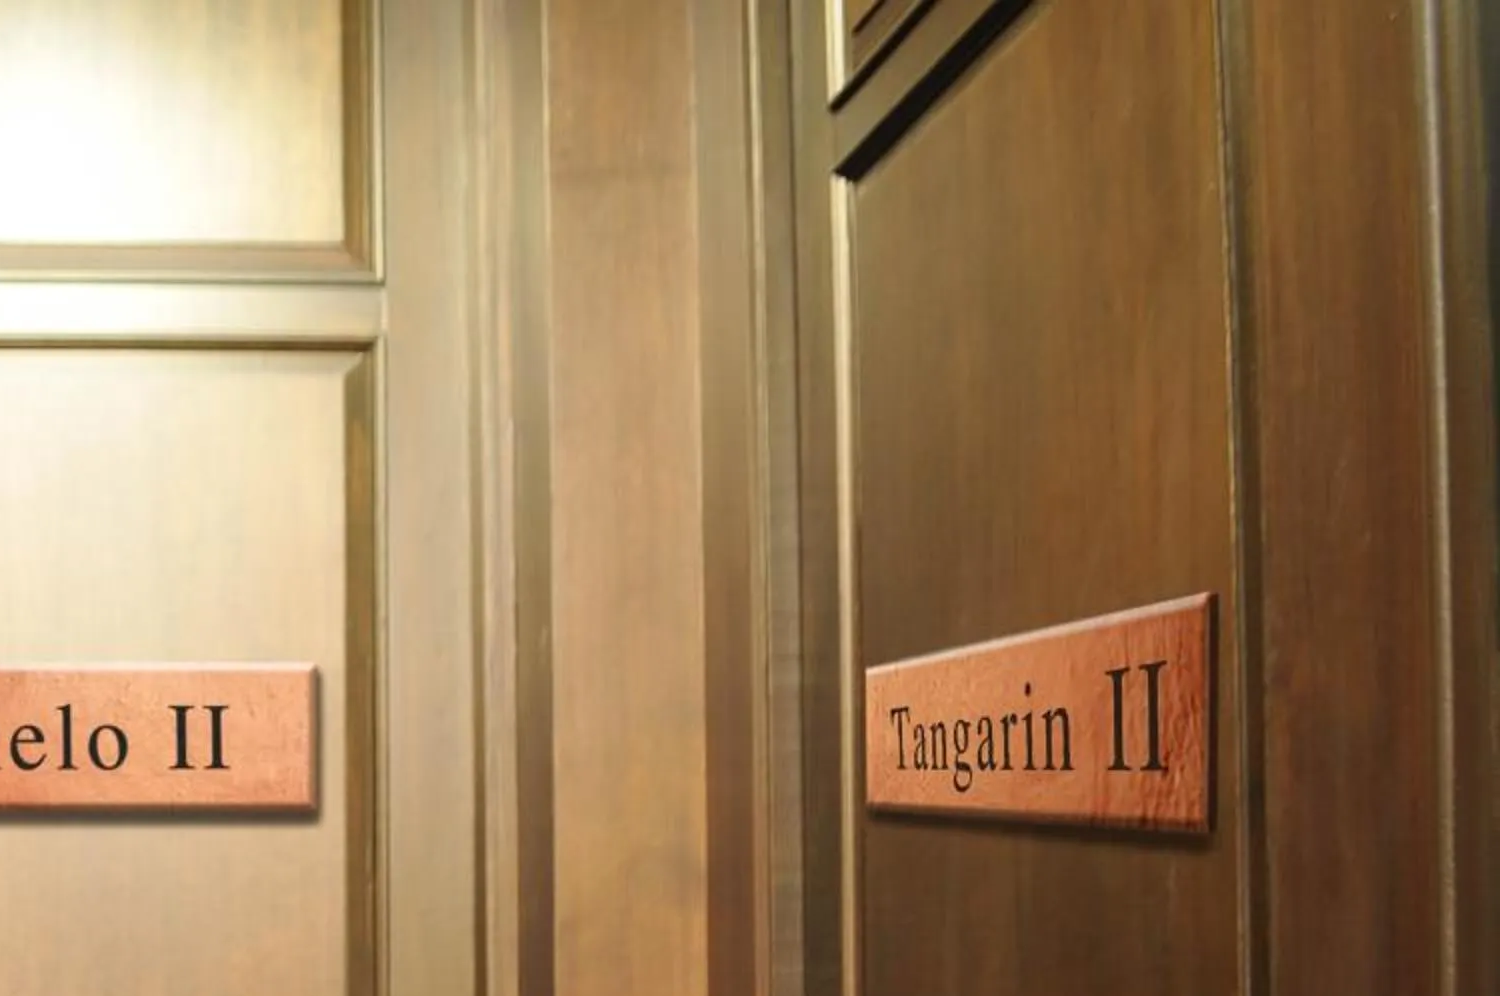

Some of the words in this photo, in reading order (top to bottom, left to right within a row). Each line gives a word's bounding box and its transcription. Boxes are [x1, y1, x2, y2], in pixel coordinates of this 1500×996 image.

[168, 704, 231, 771] II
[890, 681, 1075, 793] Tangarin
[1104, 659, 1171, 773] II
